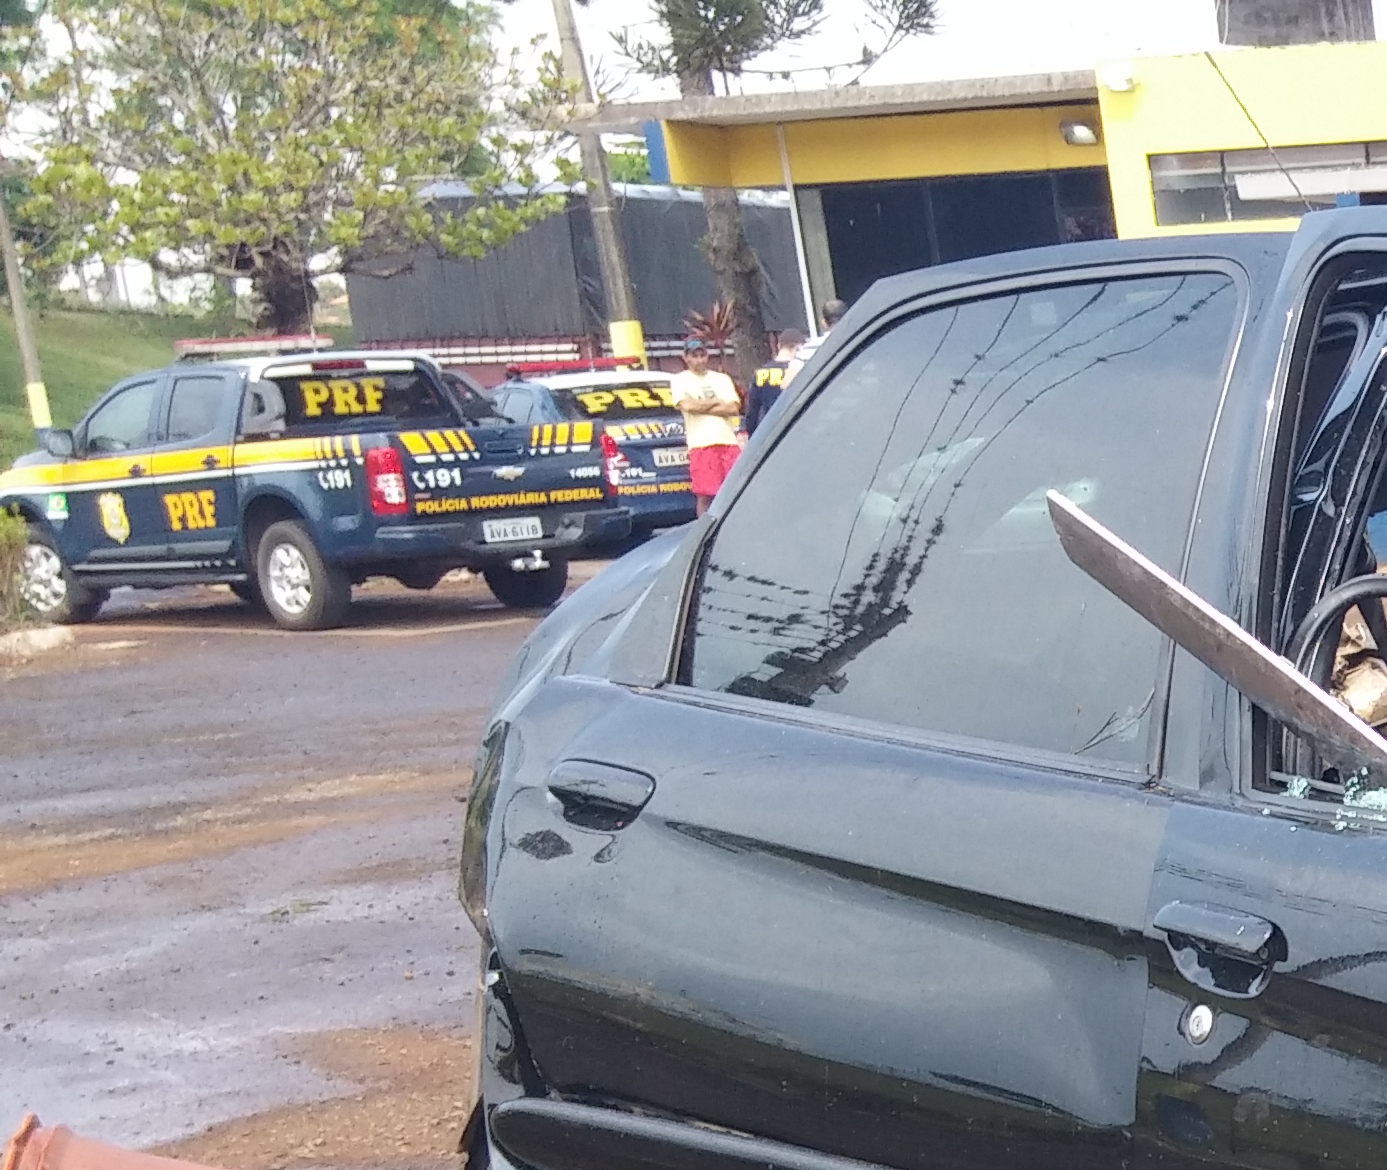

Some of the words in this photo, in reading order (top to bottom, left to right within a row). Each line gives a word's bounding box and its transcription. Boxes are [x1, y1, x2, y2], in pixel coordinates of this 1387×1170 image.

[756, 368, 783, 387] PR
[301, 377, 385, 416] PRF
[327, 469, 352, 489] 191
[425, 467, 462, 488] 191
[164, 490, 217, 532] PRF
[415, 496, 468, 514] POLÍCIA
[471, 491, 547, 509] RODOVIÁRIA
[550, 487, 604, 502] FEDERAL
